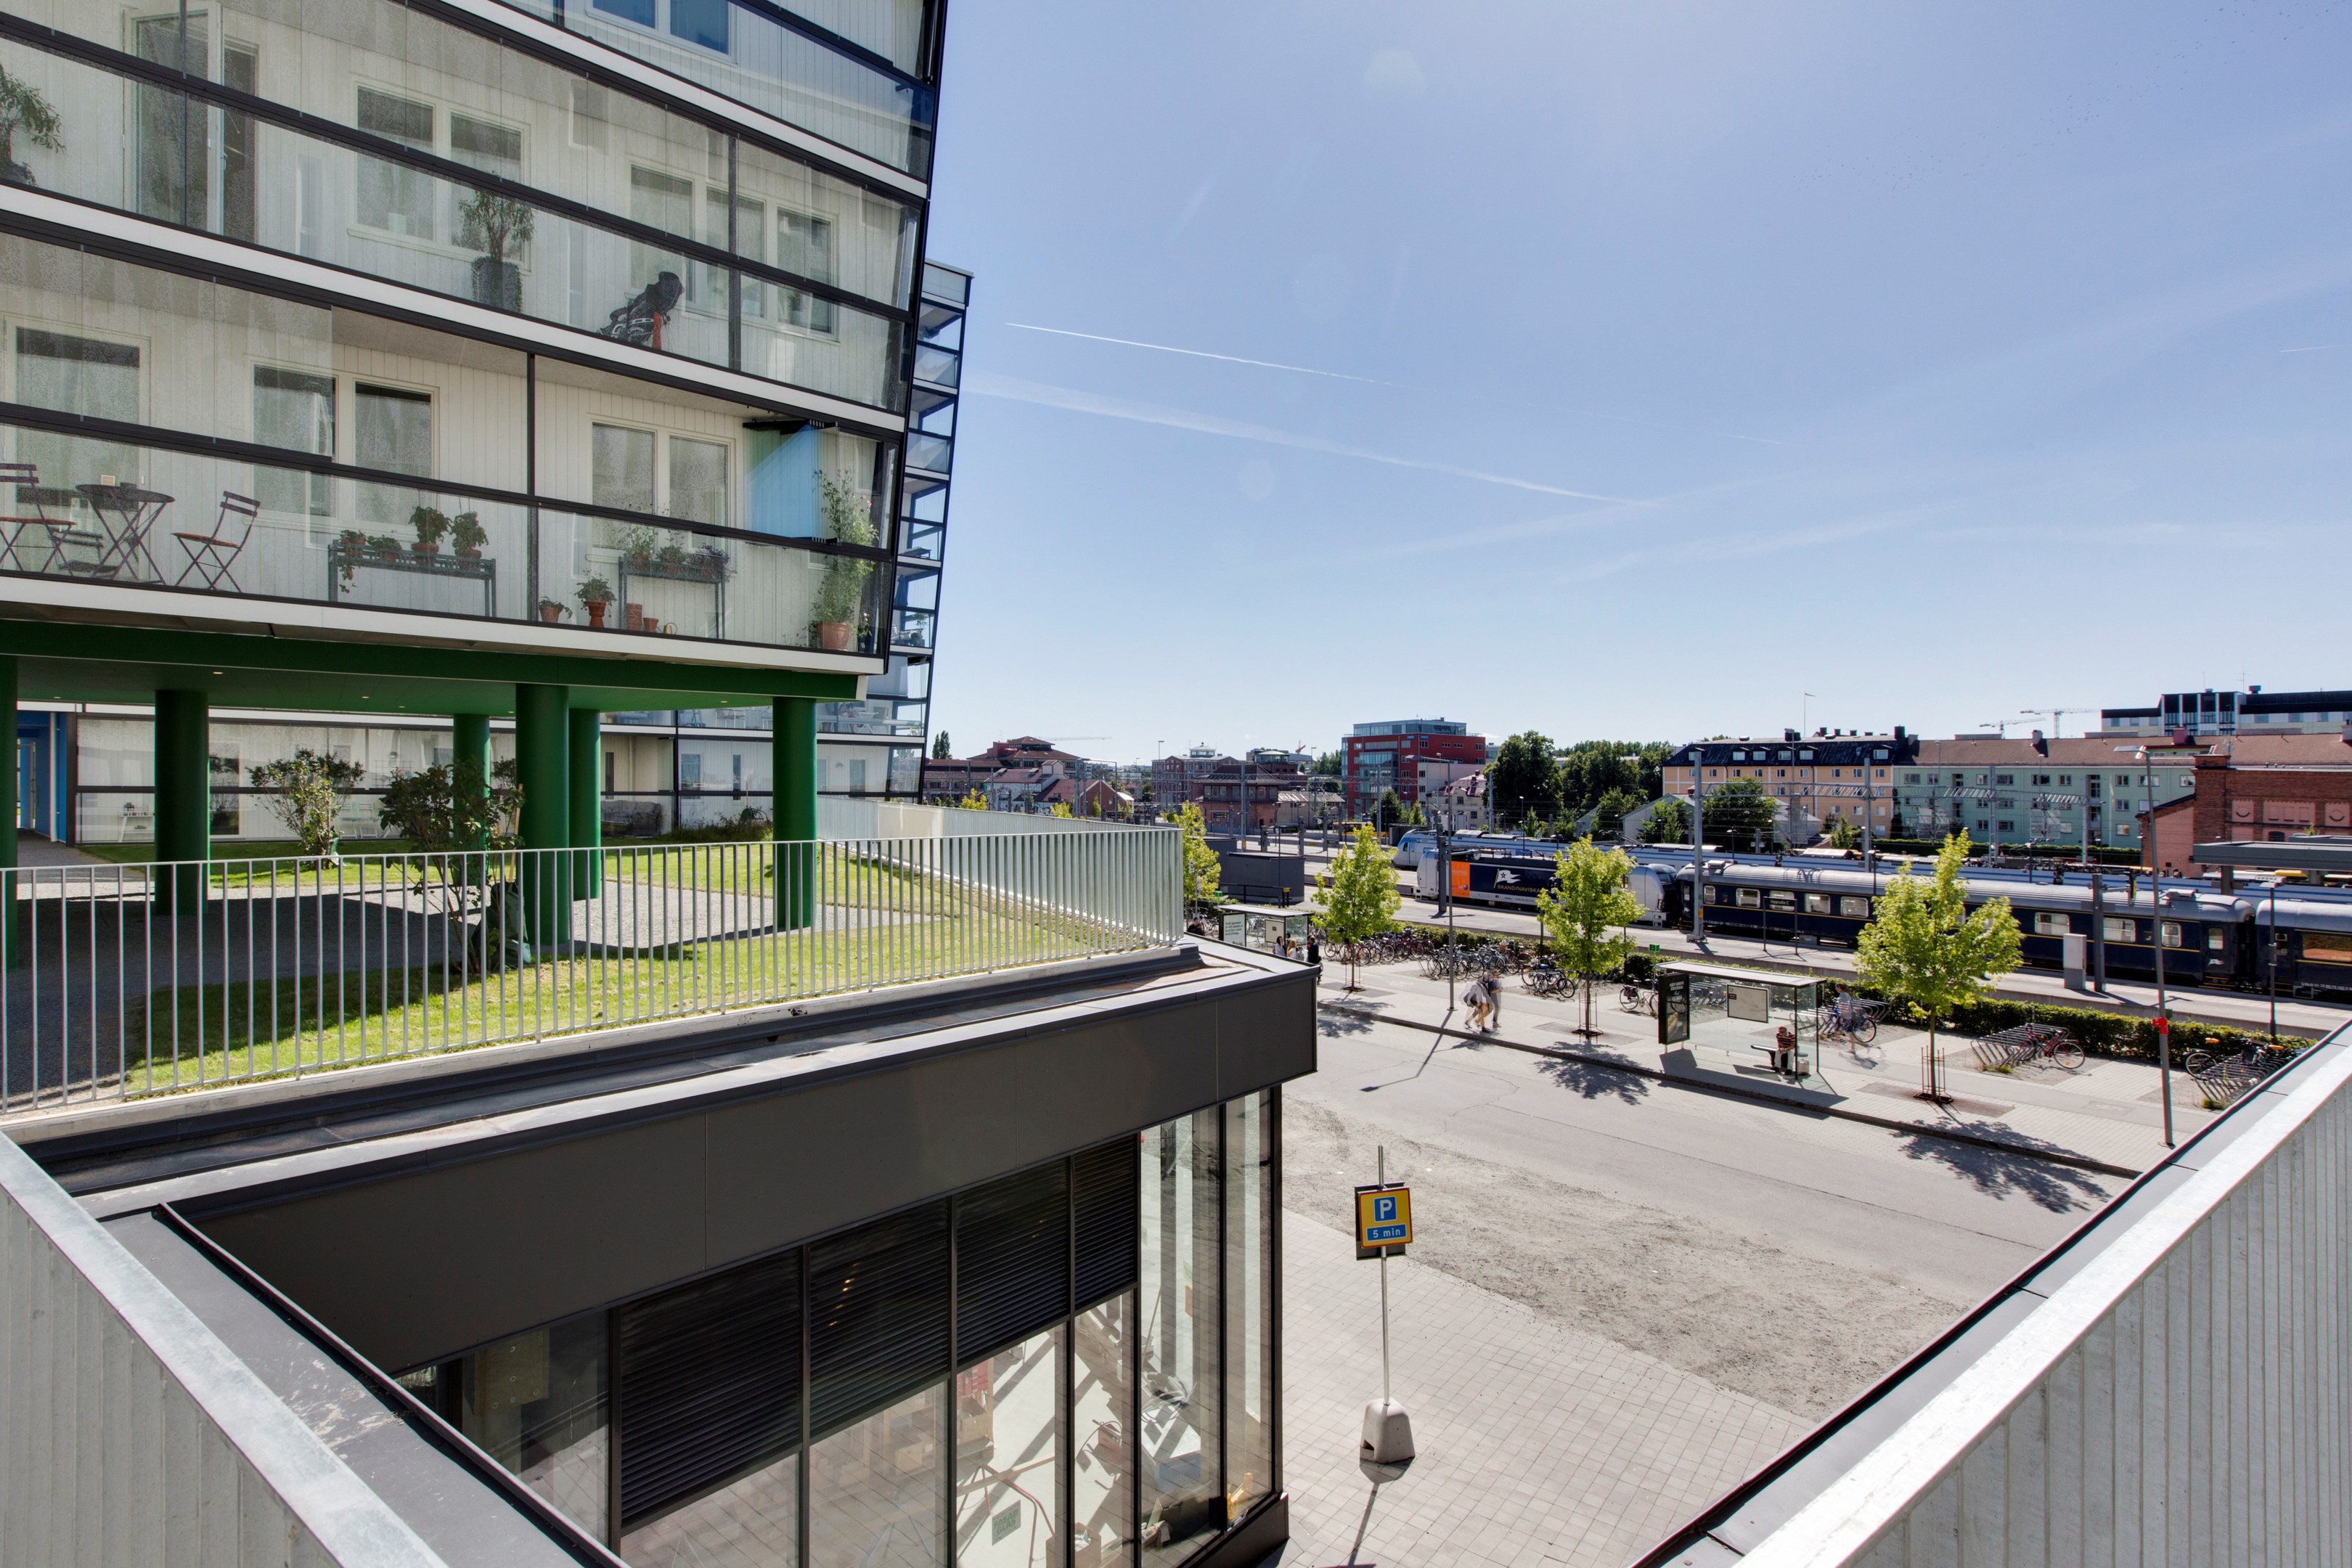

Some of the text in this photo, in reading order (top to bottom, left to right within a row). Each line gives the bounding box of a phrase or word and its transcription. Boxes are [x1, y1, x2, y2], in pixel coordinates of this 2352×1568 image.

[1498, 884, 1540, 893] SKANDINAVISKA
[1380, 1199, 1392, 1219] P
[1373, 1228, 1401, 1238] 5 min
[994, 1508, 1018, 1530] FASAD
[996, 1519, 1015, 1534] GLAS
